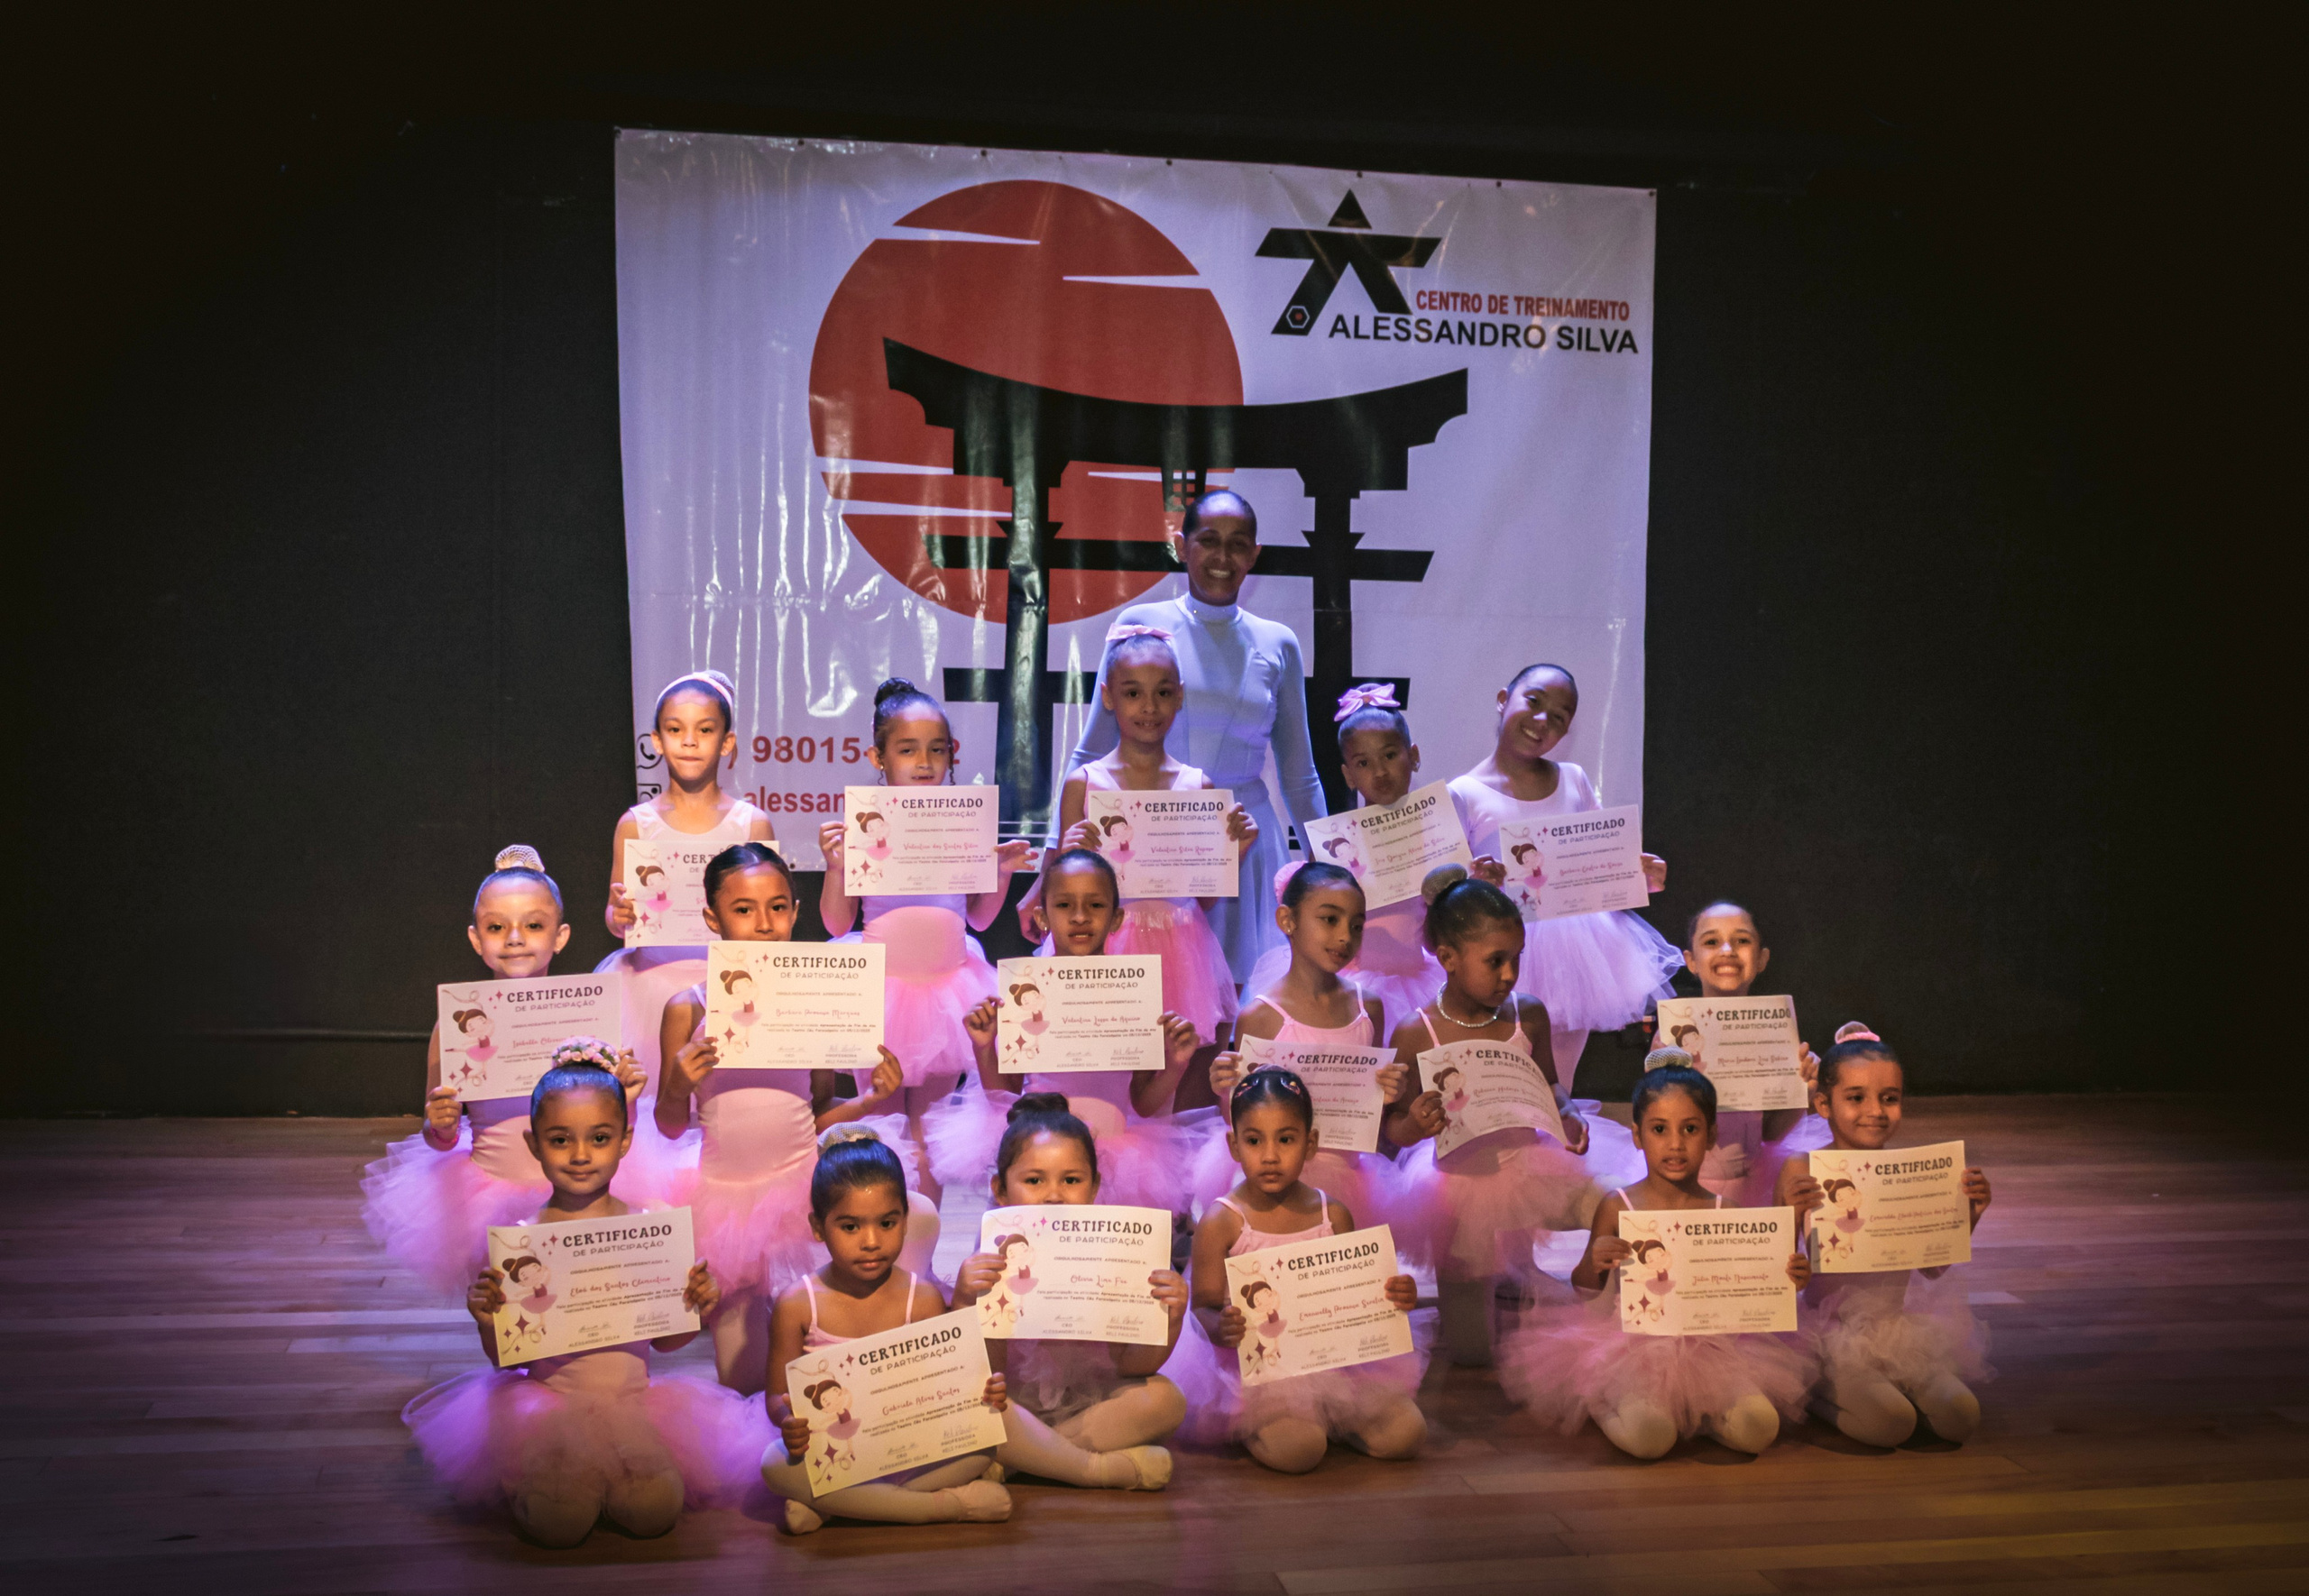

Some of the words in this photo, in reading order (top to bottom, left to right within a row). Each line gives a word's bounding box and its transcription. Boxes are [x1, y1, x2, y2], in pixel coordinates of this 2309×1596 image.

[1416, 290, 1482, 314] CENTRO
[1488, 295, 1509, 315] DE
[1513, 296, 1630, 322] TREINAMENTO
[1329, 314, 1546, 348] ALESSANDRO
[1557, 326, 1639, 354] SILVA
[901, 798, 982, 809] CERTIFICADO
[1145, 802, 1223, 812] CERTIFICADO
[1361, 797, 1436, 829] CERTIFICADO
[1550, 818, 1624, 837] CERTIFICADO
[1569, 830, 1620, 842] PARTICIPAÇÃO
[772, 956, 867, 968] CERTIFICADO
[795, 972, 859, 980] PARTICIPAÇÃO
[1057, 968, 1145, 979] CERTIFICADO
[1079, 981, 1137, 989] PARTICIPAÇÃO
[507, 986, 603, 1003] CERTIFICADO
[529, 1000, 594, 1010] PARTICIPAÇÃO
[1062, 1015, 1090, 1024] Valentina
[1716, 1008, 1791, 1021] CERTIFICADO
[1297, 1054, 1377, 1066] CERTIFICADO
[1875, 1157, 1953, 1175] CERTIFICADO
[1052, 1218, 1152, 1234] CERTIFICADO
[1684, 1222, 1777, 1235] CERTIFICADO
[563, 1225, 672, 1247] CERTIFICADO
[1075, 1235, 1144, 1246] PARTICIPAÇÃO
[1706, 1236, 1770, 1245] PARTICIPAÇÃO
[590, 1240, 664, 1255] PARTICIPAÇÃO
[1287, 1243, 1380, 1270] CERTIFICADO
[1297, 1272, 1308, 1280] DE
[1312, 1259, 1375, 1277] PARTICIPAÇÃO
[603, 1280, 629, 1291] Santos
[859, 1326, 961, 1365] CERTIFICADO
[869, 1366, 882, 1375] DE
[886, 1344, 956, 1370] PARTICIPAÇÃO
[881, 1399, 913, 1416] Gabriela
[915, 1394, 934, 1405] Alves
[936, 1386, 960, 1400] Santos
